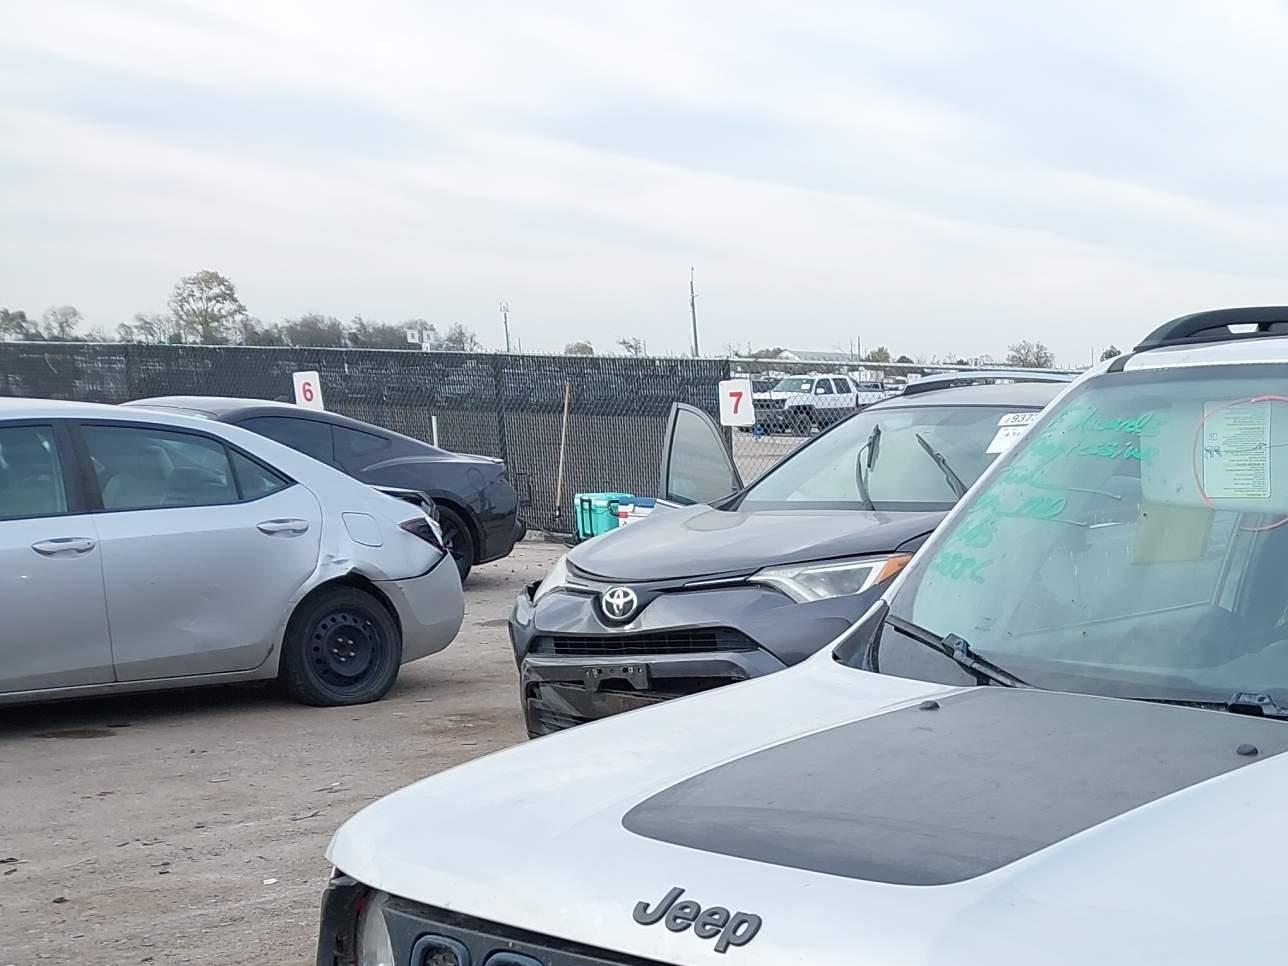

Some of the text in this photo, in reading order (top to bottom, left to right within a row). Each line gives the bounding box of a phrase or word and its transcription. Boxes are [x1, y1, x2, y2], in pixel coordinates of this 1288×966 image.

[301, 381, 314, 403] 6
[728, 391, 744, 415] 7
[632, 886, 763, 955] Jeep
